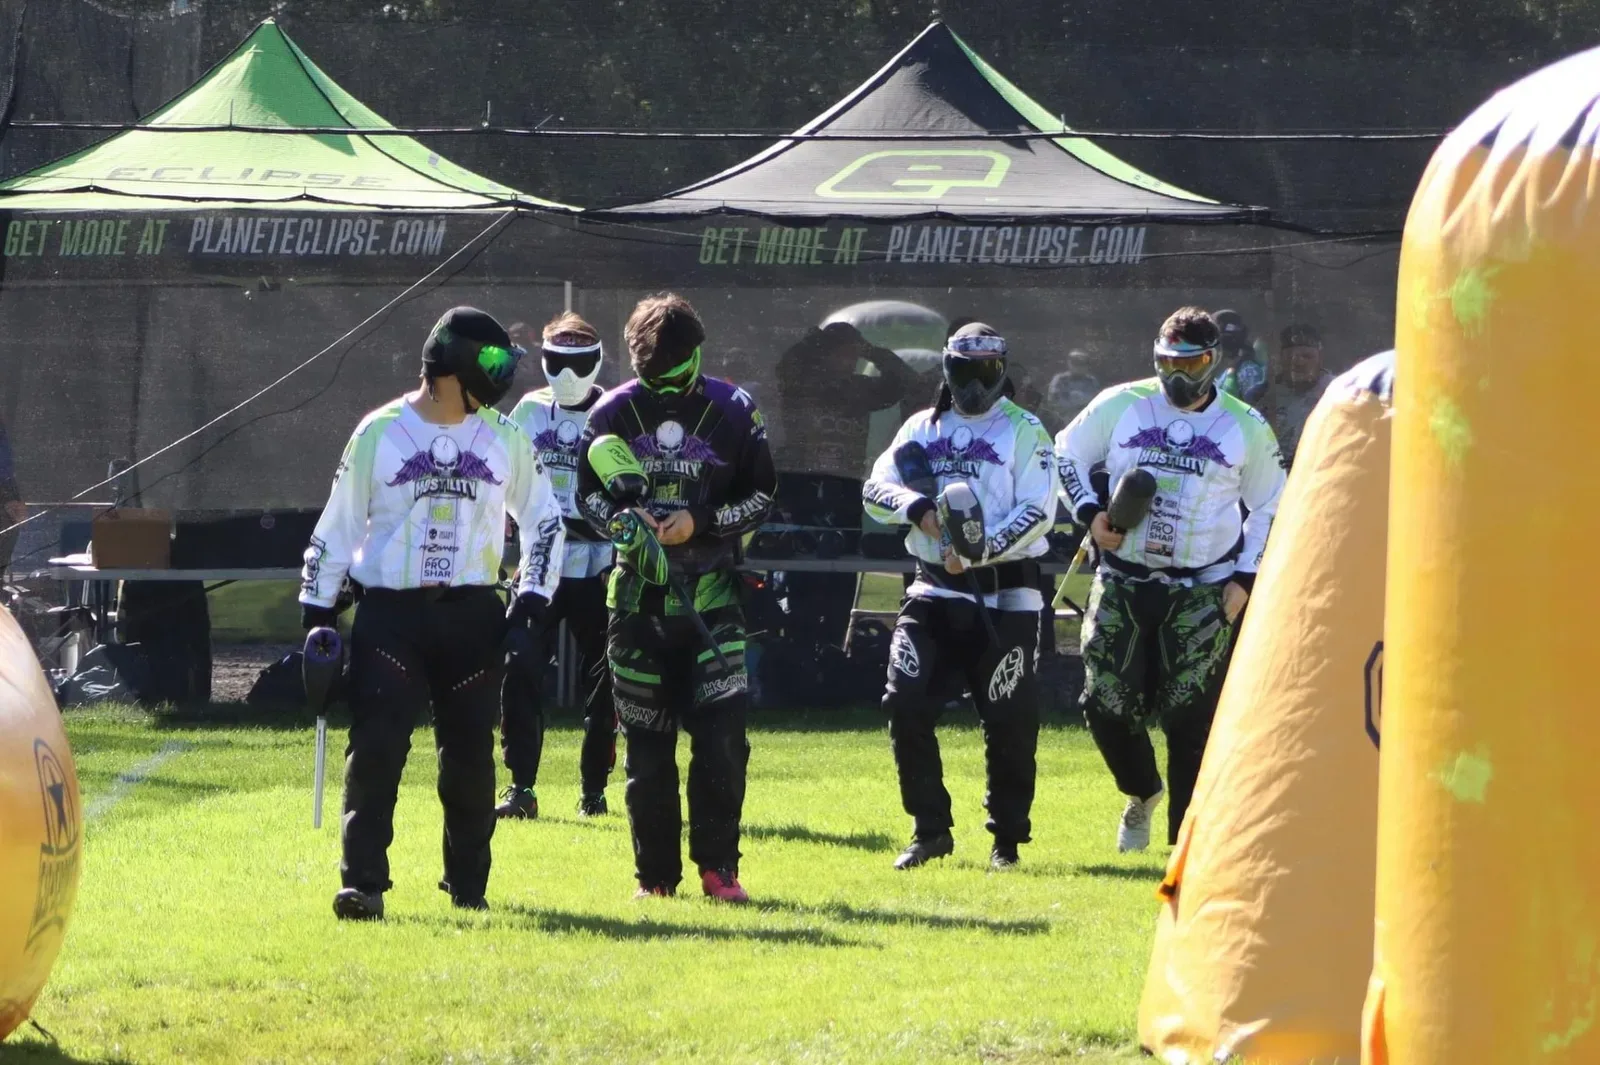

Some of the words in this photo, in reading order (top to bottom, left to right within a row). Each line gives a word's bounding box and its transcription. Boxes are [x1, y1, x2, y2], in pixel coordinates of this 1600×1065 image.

[106, 167, 393, 188] ECLIPSE
[4, 220, 52, 257] GET
[58, 219, 130, 257] MORE
[136, 219, 170, 255] AT
[187, 216, 447, 256] PLANETECLIPSE.COM
[699, 226, 749, 265] GET
[754, 226, 828, 265] MORE
[833, 227, 868, 265] AT
[885, 225, 1146, 265] PLANETECLIPSE.COM
[1137, 449, 1207, 477] HOSTILITY
[414, 478, 477, 501] HOSTILITY
[1149, 532, 1174, 543] SHAR
[1150, 522, 1174, 535] PRO
[424, 558, 450, 570] PRO
[424, 570, 451, 578] SHAR
